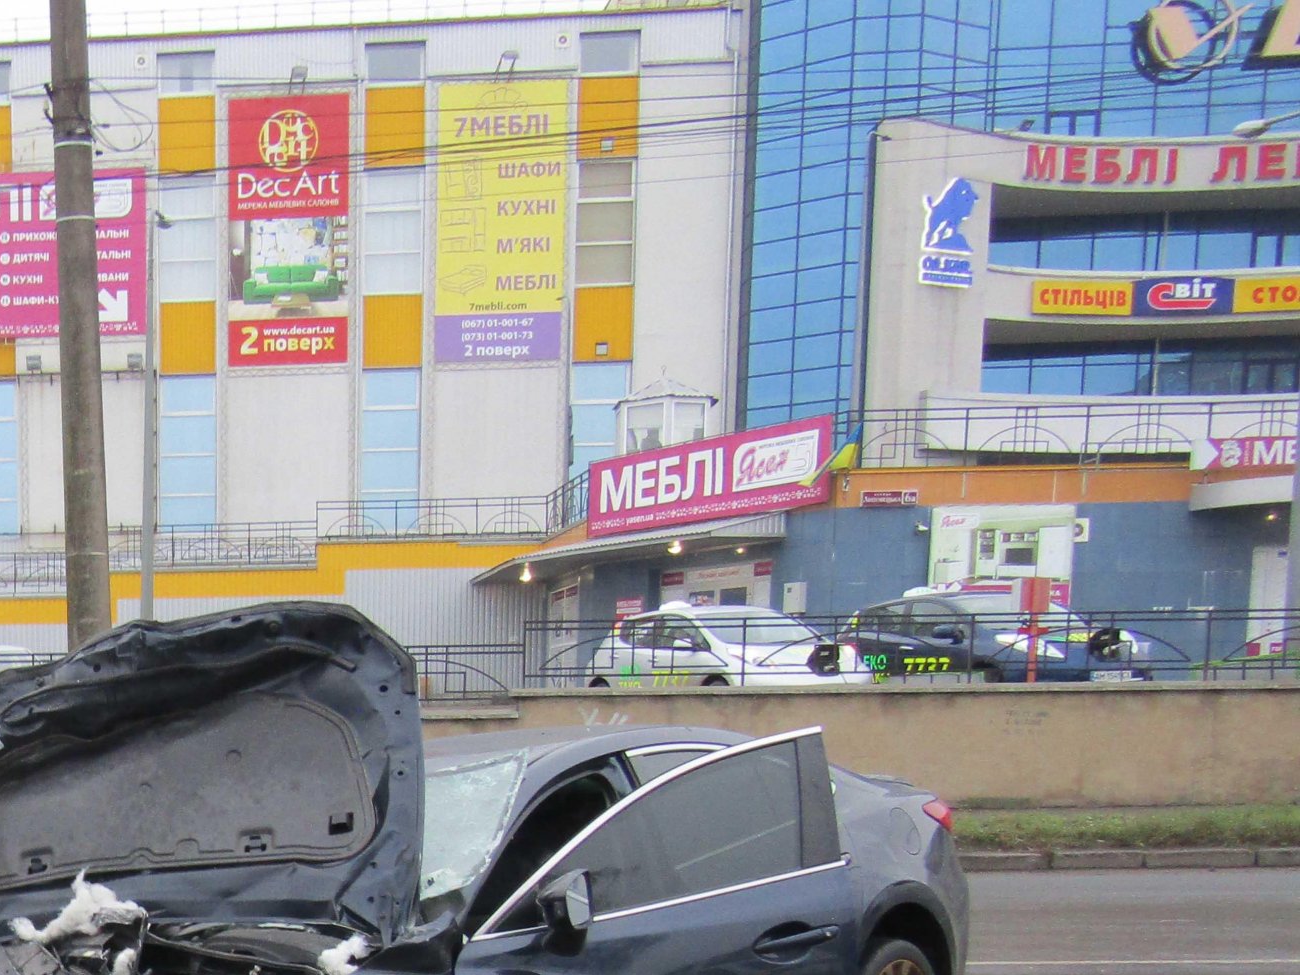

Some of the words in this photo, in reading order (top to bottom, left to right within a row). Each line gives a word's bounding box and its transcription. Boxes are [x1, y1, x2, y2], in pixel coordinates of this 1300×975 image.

[454, 114, 549, 137] 7МЕБЛІ
[498, 161, 561, 179] ШАФИ
[1025, 144, 1179, 185] МЕБЛІ
[1209, 143, 1300, 183] ЛЕ
[497, 200, 556, 217] КУХНІ
[496, 236, 551, 254] М'ЯКІ
[12, 252, 50, 265] ДИТЯЧІ
[12, 275, 43, 286] КУХНІ
[495, 275, 557, 292] МЕБЛІ
[1039, 287, 1128, 309] СТІЛЬЦІВ
[1251, 285, 1300, 305] СТО
[468, 301, 528, 312] 7mebli.com
[263, 324, 336, 336] www.decart.ua
[461, 319, 486, 329] (067)
[487, 317, 535, 328] 01-001-67
[240, 325, 259, 356] 2
[263, 336, 336, 356] поверх
[461, 332, 486, 342] (073)
[487, 330, 534, 341] 01-001-73
[463, 344, 474, 357] 2
[476, 345, 531, 359] поверх
[599, 447, 724, 514] МЕБЛІ
[625, 513, 654, 526] yasen.ua
